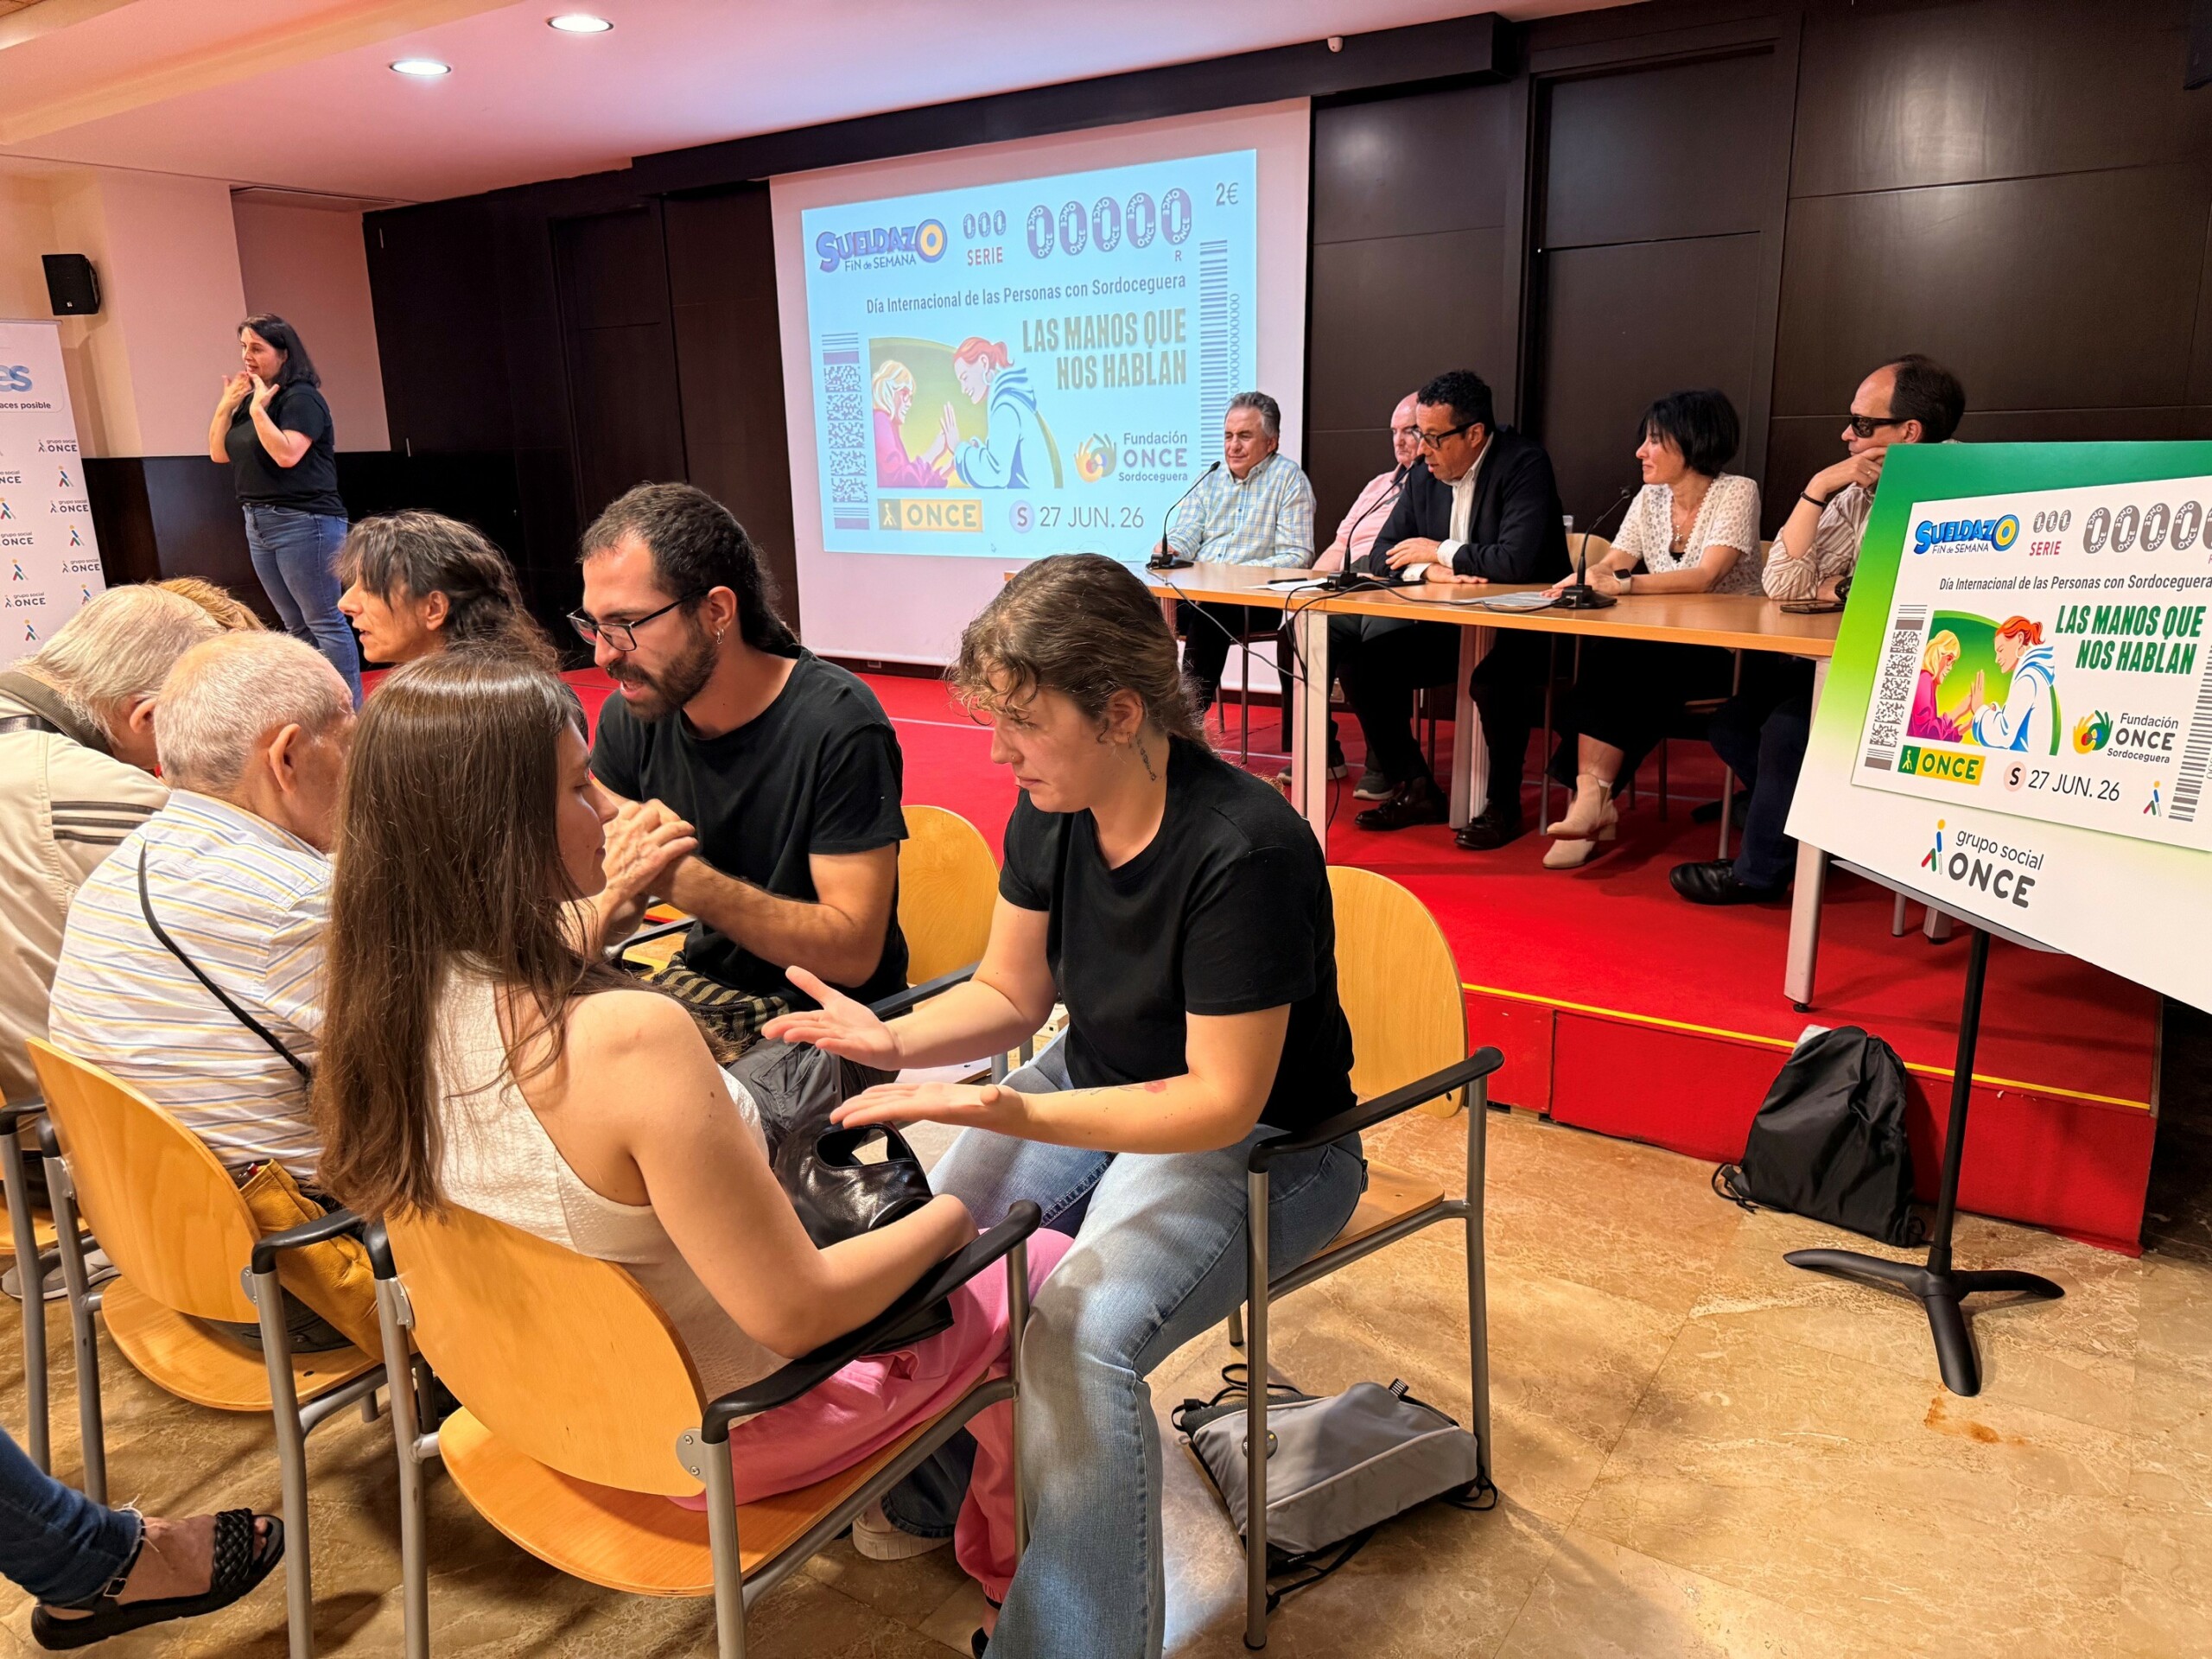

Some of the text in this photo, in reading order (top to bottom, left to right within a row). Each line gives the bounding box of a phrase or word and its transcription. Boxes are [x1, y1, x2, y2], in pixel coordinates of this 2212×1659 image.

[1163, 190, 1179, 215] ONCE
[1216, 182, 1239, 207] 2€
[1060, 203, 1076, 227] ONCE
[1093, 200, 1109, 223] ONCE
[1128, 194, 1144, 219] ONCE
[963, 210, 1007, 239] 000
[1027, 188, 1192, 259] 00000
[1028, 207, 1044, 230] ONCE
[1070, 229, 1086, 254] ONCE
[1103, 226, 1120, 251] ONCE
[1137, 222, 1154, 247] ONCE
[1173, 218, 1190, 243] ONCE
[816, 219, 948, 273] SUELDAZO
[967, 246, 1003, 266] SERIE
[1038, 233, 1052, 257] ONCE
[1174, 250, 1182, 262] R
[863, 262, 872, 270] de
[874, 254, 917, 270] SEMANA
[867, 275, 1185, 314] Día Internacional de las Personas con Sordoceguera
[1022, 308, 1186, 353] LAS MANOS QUE
[1057, 350, 1186, 390] NOS HABLAN
[48, 444, 78, 453] ONCE
[1124, 431, 1187, 445] Fundación
[1123, 448, 1187, 467] ONCE
[1119, 471, 1188, 483] Sordoceguera
[60, 505, 89, 513] ONCE
[907, 504, 977, 528] ONCE
[1017, 506, 1028, 527] S
[1039, 506, 1144, 529] 27 JUN. 26
[2088, 509, 2104, 529] ONCE
[2115, 506, 2133, 527] ONCE
[2145, 505, 2163, 526] ONCE
[2176, 503, 2194, 524] ONCE
[2033, 509, 2072, 533] 000
[2, 537, 34, 546] ONCE
[1913, 514, 2020, 555] SUELDAZO
[2090, 531, 2107, 552] ONCE
[2118, 531, 2135, 550] ONCE
[2147, 529, 2165, 550] ONCE
[2178, 527, 2197, 549] ONCE
[1955, 543, 1989, 553] SEMANA
[2029, 541, 2062, 556] SERIE
[72, 563, 100, 572] ONCE
[1940, 574, 2212, 592] Día Internacional de las Personas con Sordoceguera
[15, 598, 46, 607] ONCE
[2056, 605, 2207, 639] LAS MANOS QUE
[2075, 639, 2198, 675] NOS HABLAN
[2120, 713, 2179, 729] Fundación
[2115, 728, 2176, 751] ONCE
[1922, 753, 1980, 780] ONCE
[2107, 747, 2171, 764] Sordoceguera
[2009, 767, 2021, 786] S
[2028, 769, 2120, 802] 27 JUN. 26
[1955, 830, 2044, 871] grupo social
[1948, 852, 2036, 908] ONCE
